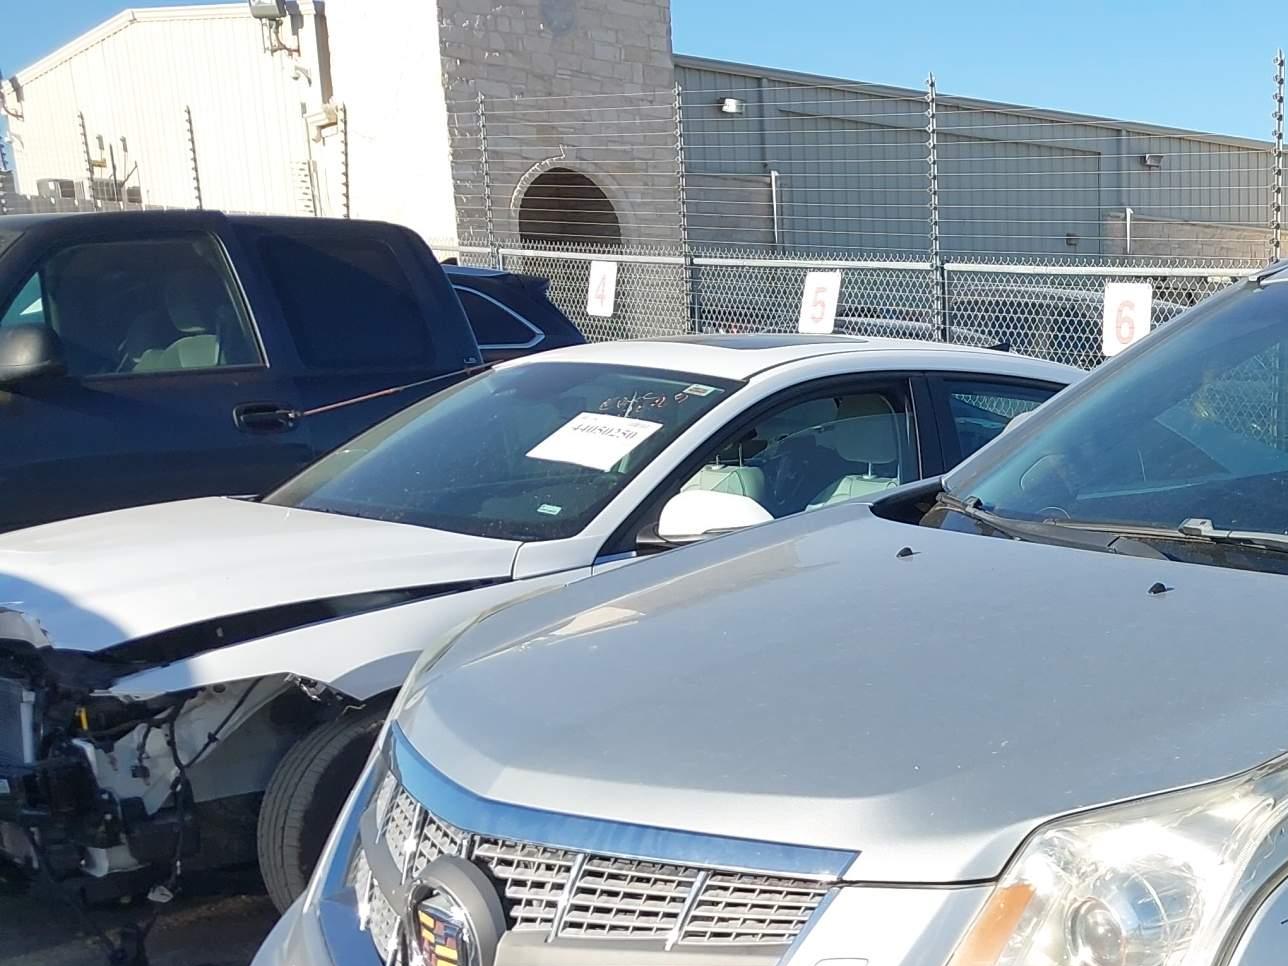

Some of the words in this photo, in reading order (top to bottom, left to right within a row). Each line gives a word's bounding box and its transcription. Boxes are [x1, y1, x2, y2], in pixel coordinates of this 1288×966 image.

[594, 273, 607, 308] 4
[810, 286, 828, 324] 5
[1116, 301, 1135, 344] 6
